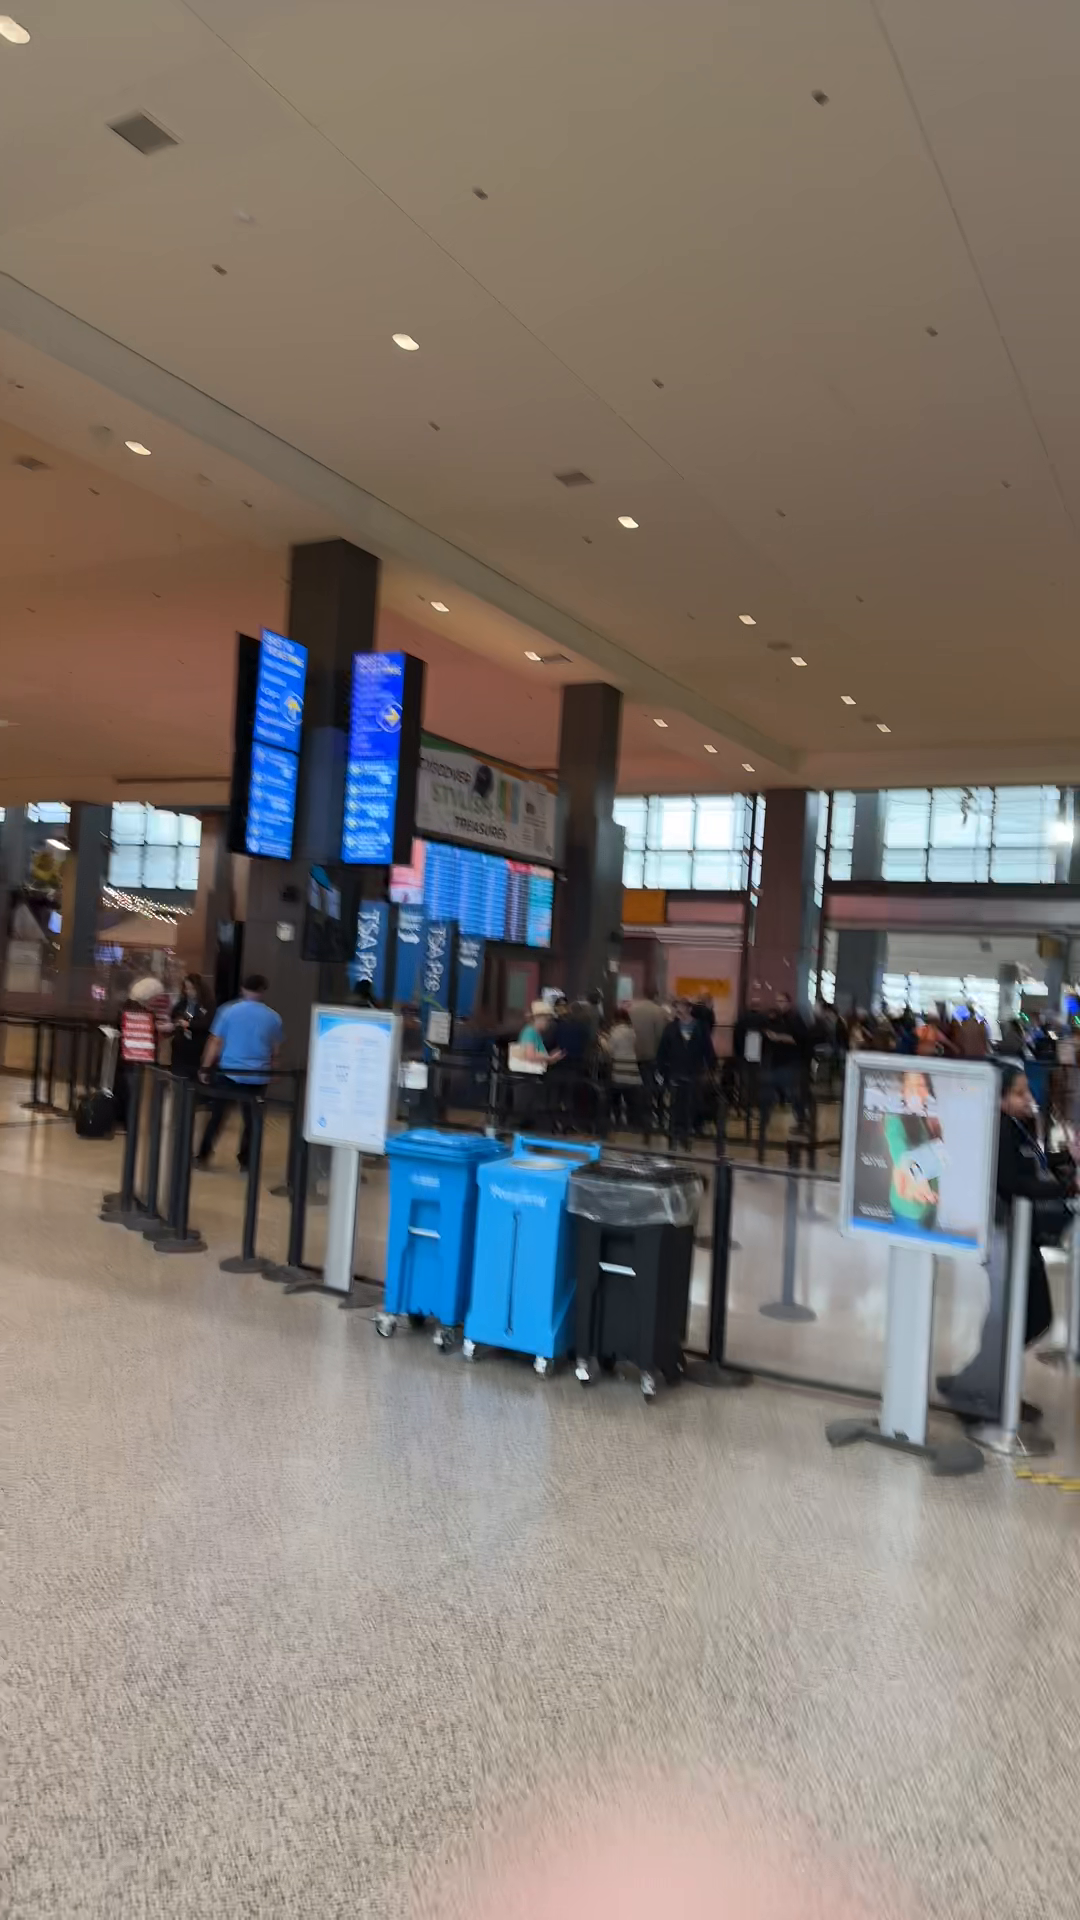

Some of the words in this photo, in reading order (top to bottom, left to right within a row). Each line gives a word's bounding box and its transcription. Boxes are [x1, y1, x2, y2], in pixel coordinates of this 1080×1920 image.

[454, 815, 508, 840] TREASURES
[357, 909, 380, 950] TSA
[426, 927, 447, 960] TSA
